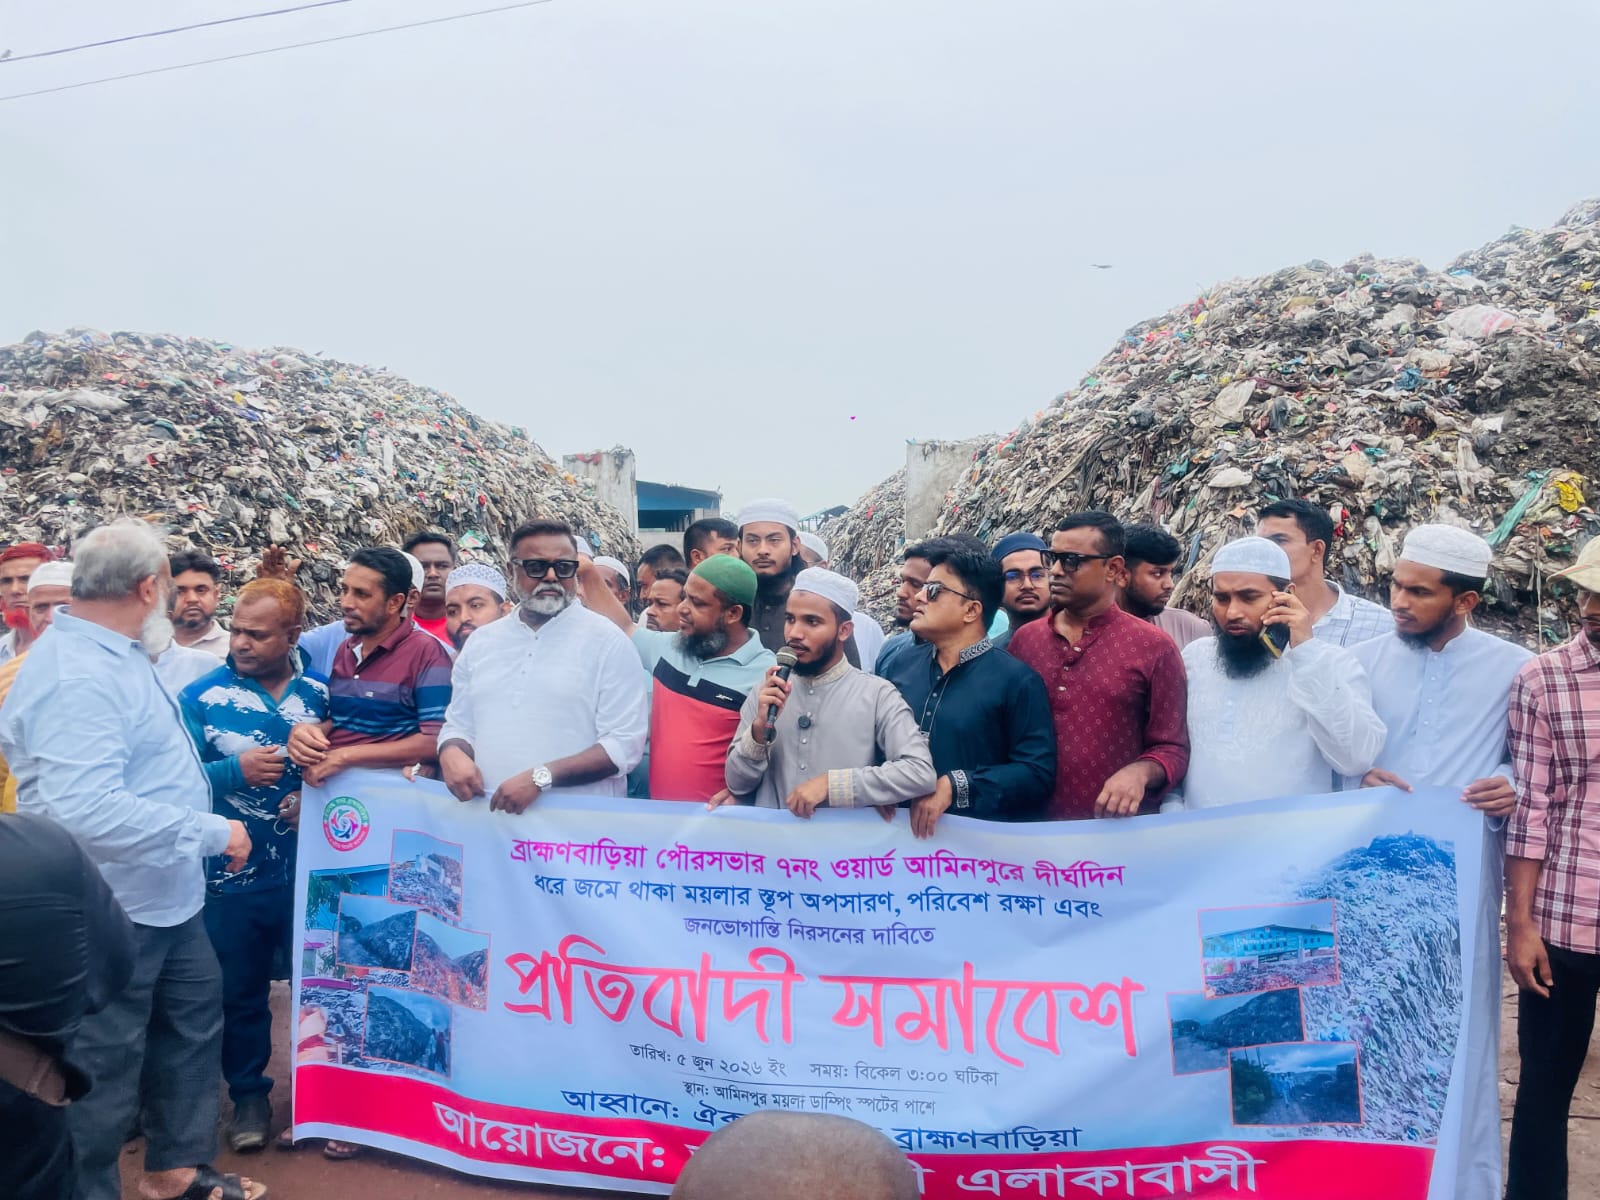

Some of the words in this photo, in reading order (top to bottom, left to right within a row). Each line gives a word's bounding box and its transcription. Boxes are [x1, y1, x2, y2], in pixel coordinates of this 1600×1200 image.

[510, 838, 648, 871] ব্রাহ্মণবাড়িয়া
[656, 841, 766, 874] পৌরসভার
[776, 858, 822, 881] ৭নং
[829, 849, 896, 880] ওয়ার্ড
[902, 849, 1025, 886] আমিনপুরে
[1033, 860, 1126, 888] দীর্ঘদিন
[534, 875, 567, 897] ধরে
[574, 879, 621, 900] জমে
[628, 881, 677, 903] থাকা
[683, 885, 752, 906] ময়লার
[800, 891, 902, 917] অপসারণ,
[907, 886, 991, 914] পরিবেশ
[998, 893, 1046, 916] রক্ষা
[1054, 899, 1104, 919] এবং
[684, 916, 782, 939] জনভোগান্তি
[789, 919, 867, 945] নিরসনের
[871, 922, 937, 946] দাবিতে
[503, 934, 806, 1044] প্রতিবাদী
[817, 960, 1146, 1069] সমাবেশ
[677, 1053, 687, 1066] ৫
[692, 1054, 714, 1071] জুন
[768, 1058, 788, 1077] ইং
[855, 1060, 902, 1081] বিকেল
[954, 1066, 1000, 1087] ঘটিকা
[713, 1085, 767, 1108] আমিনপুর
[904, 1100, 936, 1116] পাশে
[891, 1126, 1083, 1152] ব্রাহ্মণবাড়িয়া
[956, 1145, 1267, 1198] এলাকাবাসী
